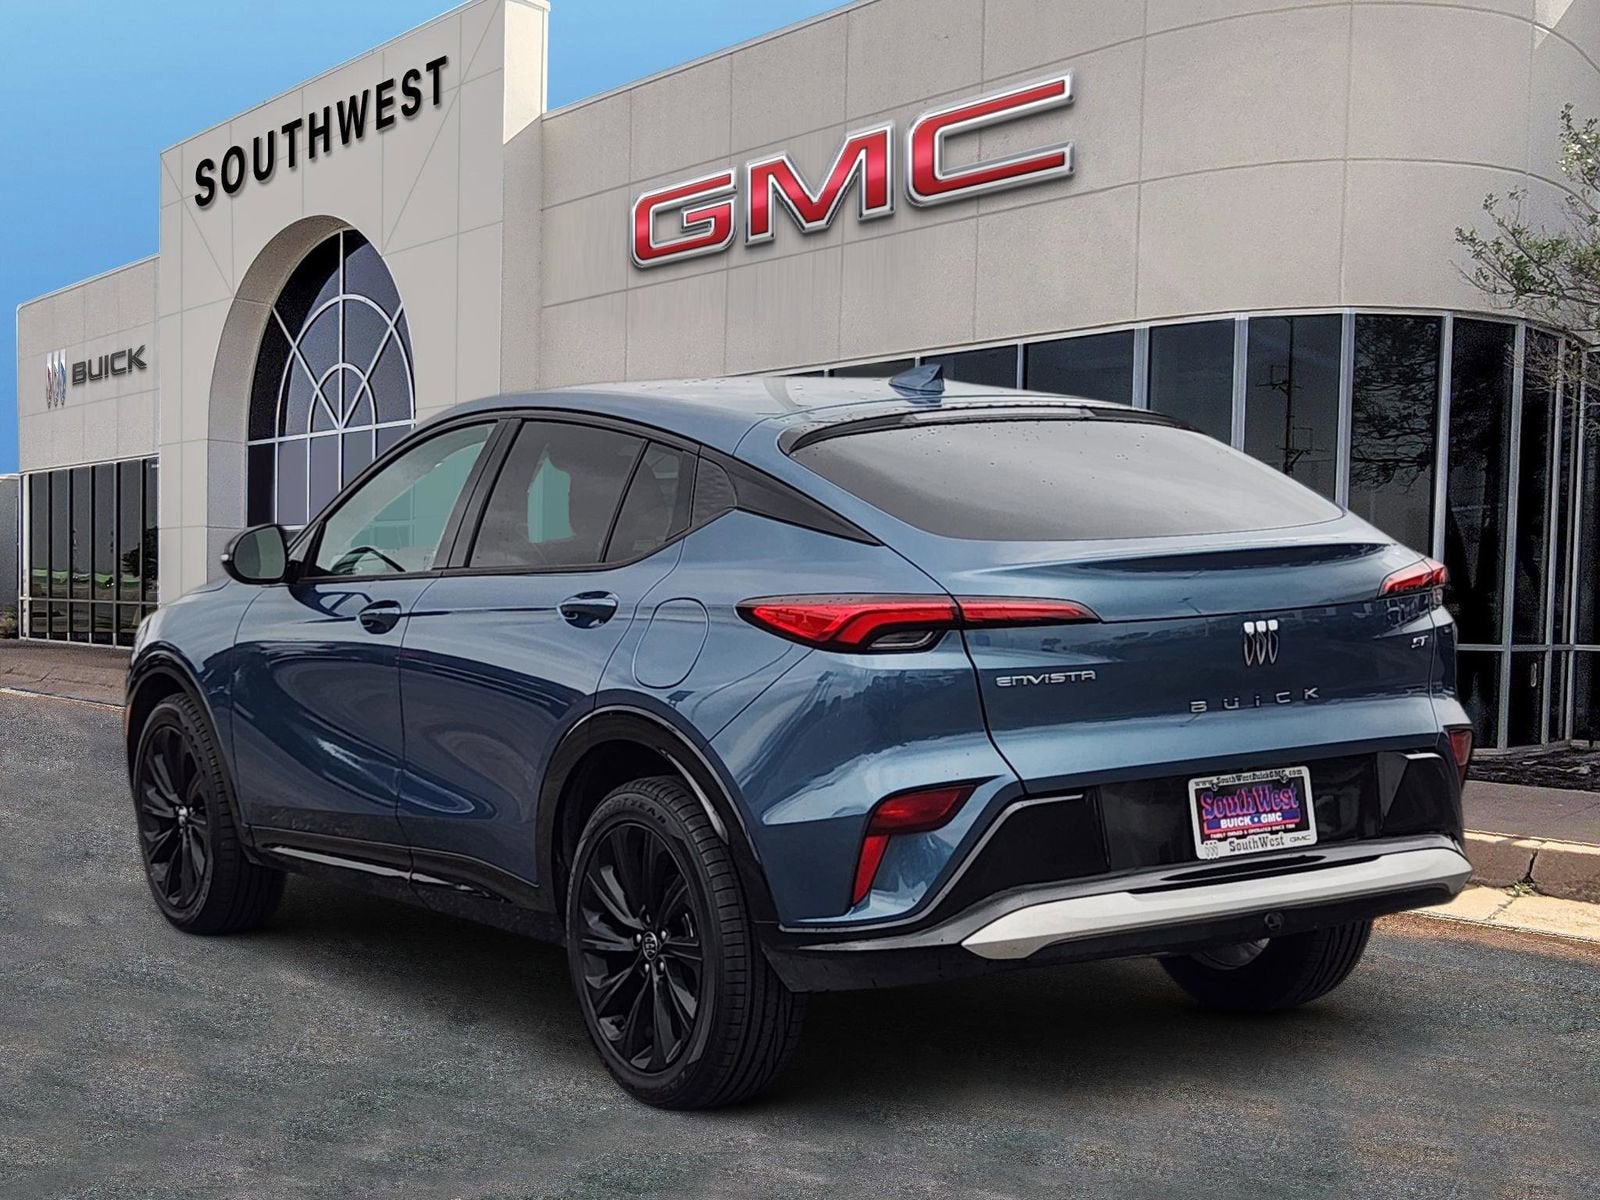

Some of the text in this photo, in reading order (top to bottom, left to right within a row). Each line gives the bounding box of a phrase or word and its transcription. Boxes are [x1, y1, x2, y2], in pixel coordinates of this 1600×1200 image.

[194, 55, 449, 208] SOUTHWEST
[630, 69, 1075, 269] GMC
[71, 344, 147, 387] BUICK
[994, 669, 1097, 687] ENVISTA
[1189, 687, 1320, 714] BUICK
[1200, 784, 1299, 820] SouthWest
[1220, 812, 1283, 829] BUICK GMC
[1229, 834, 1312, 852] SouthWest GMC
